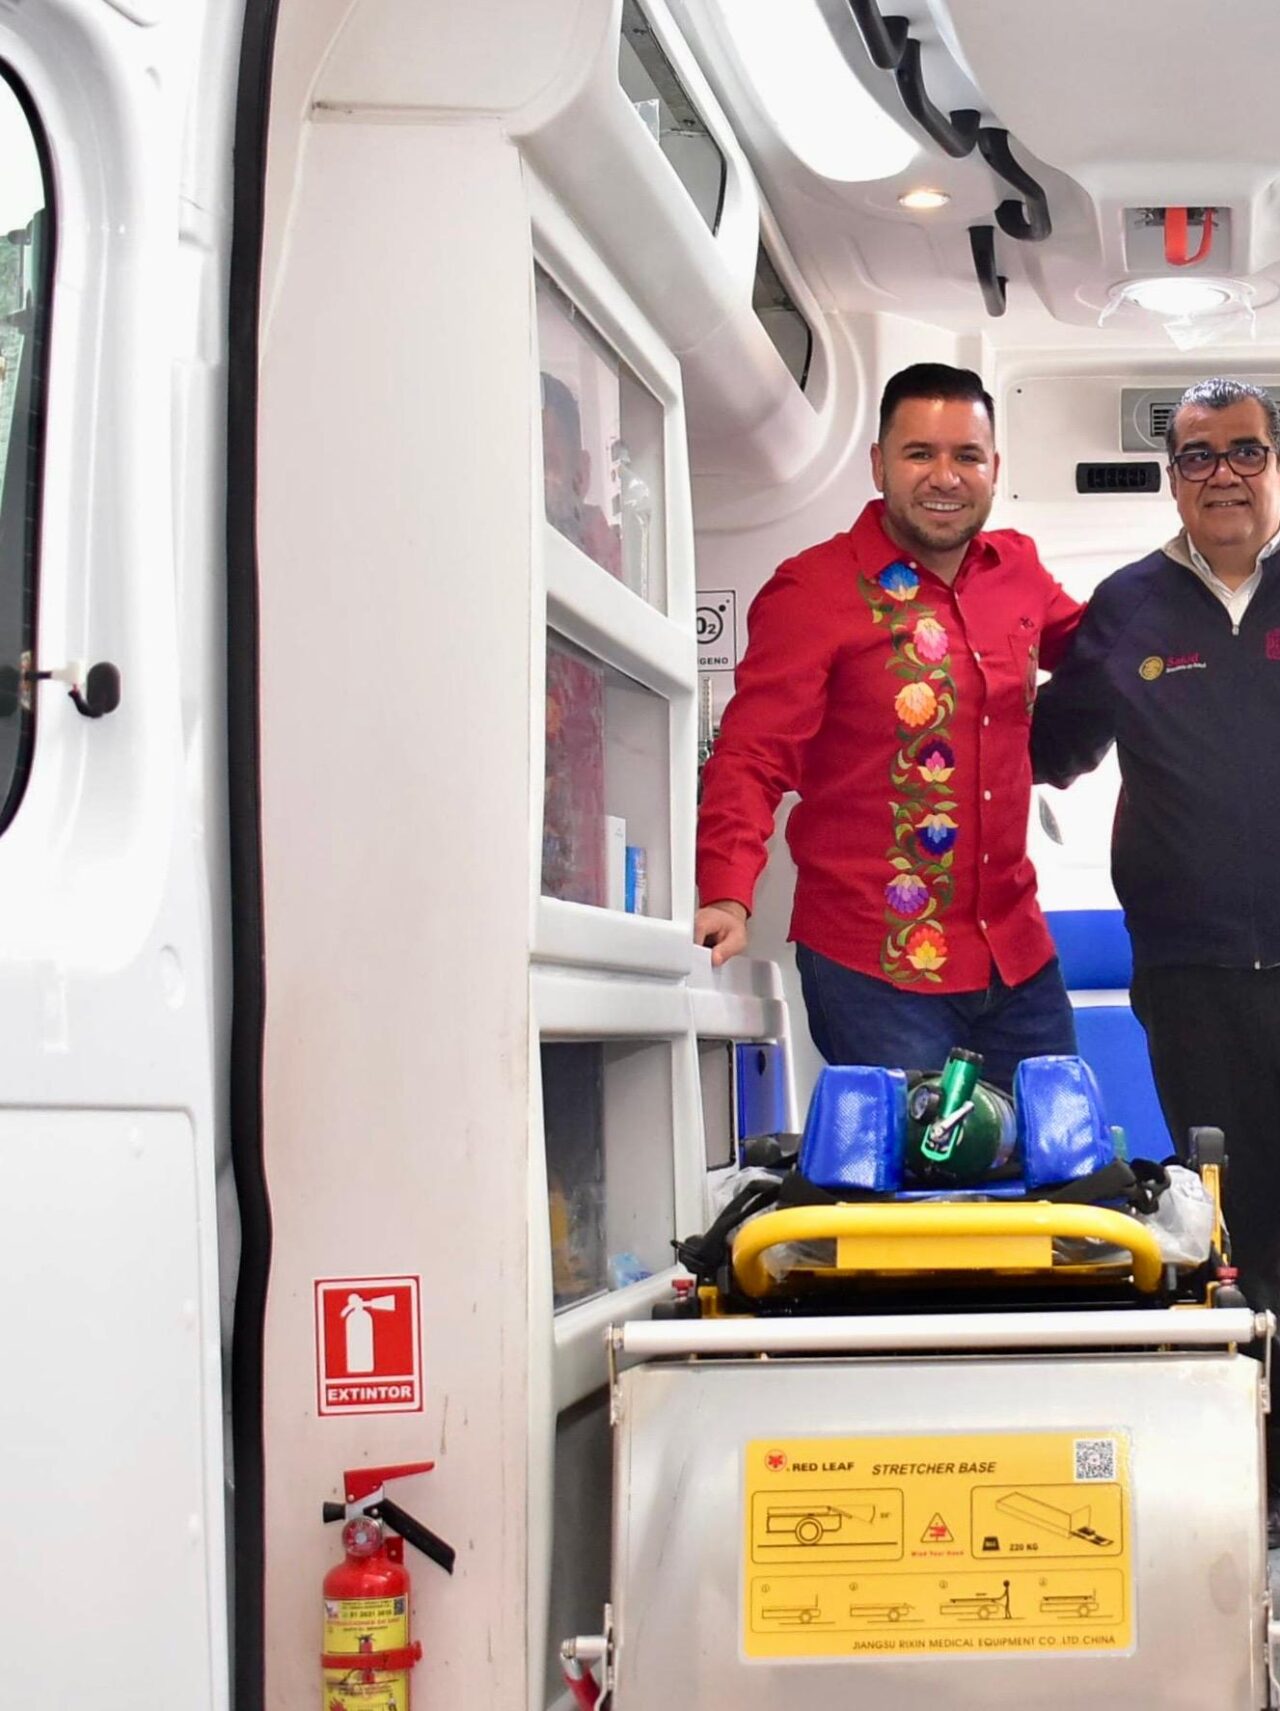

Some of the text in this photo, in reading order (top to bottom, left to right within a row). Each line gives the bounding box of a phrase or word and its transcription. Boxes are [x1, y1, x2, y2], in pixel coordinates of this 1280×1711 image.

[699, 657, 729, 665] GENO
[327, 1385, 412, 1401] EXTINTOR
[792, 1462, 855, 1472] RED LEAF
[872, 1462, 997, 1475] STRETCHER BASE
[853, 1640, 896, 1650] JIANGSU
[929, 1638, 974, 1648] MEDICAL
[978, 1637, 1035, 1647] EQUIPMENT
